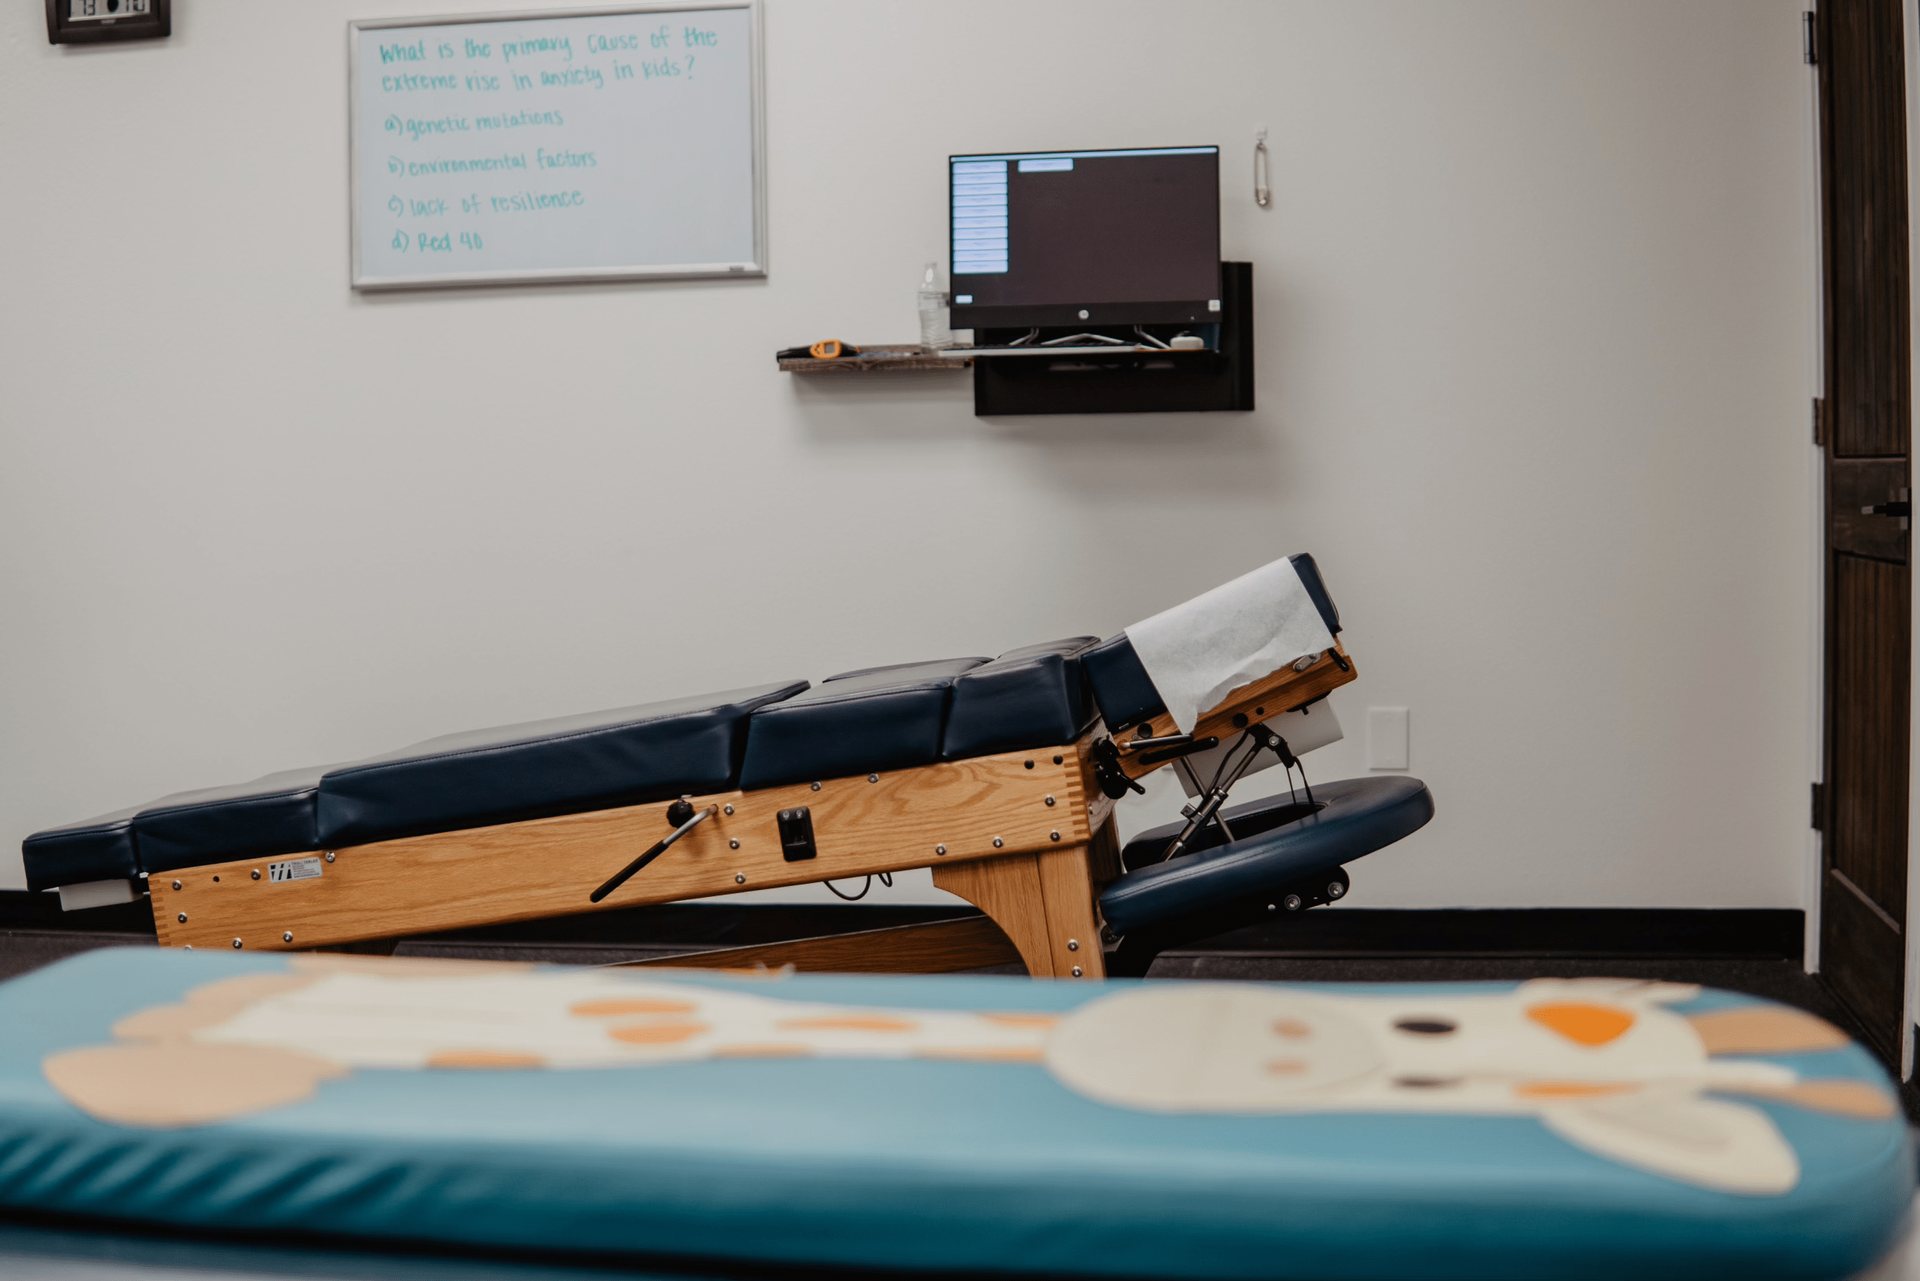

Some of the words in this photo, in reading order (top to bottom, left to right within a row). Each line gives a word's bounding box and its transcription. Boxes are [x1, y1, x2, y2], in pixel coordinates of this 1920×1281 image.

[380, 39, 426, 64] What
[438, 38, 455, 60] is
[464, 38, 491, 59] the
[502, 36, 573, 62] primary
[650, 24, 670, 48] of
[684, 26, 718, 48] the
[382, 73, 457, 92] extreme
[465, 69, 500, 91] rise
[511, 69, 533, 91] in
[541, 64, 604, 90] anxiety
[612, 58, 634, 80] in
[475, 109, 564, 131] mutations
[537, 147, 597, 170] factors
[410, 197, 449, 217] lack
[461, 193, 481, 214] of
[490, 190, 585, 212] resilience
[418, 232, 452, 253] Red
[460, 231, 484, 251] 40
